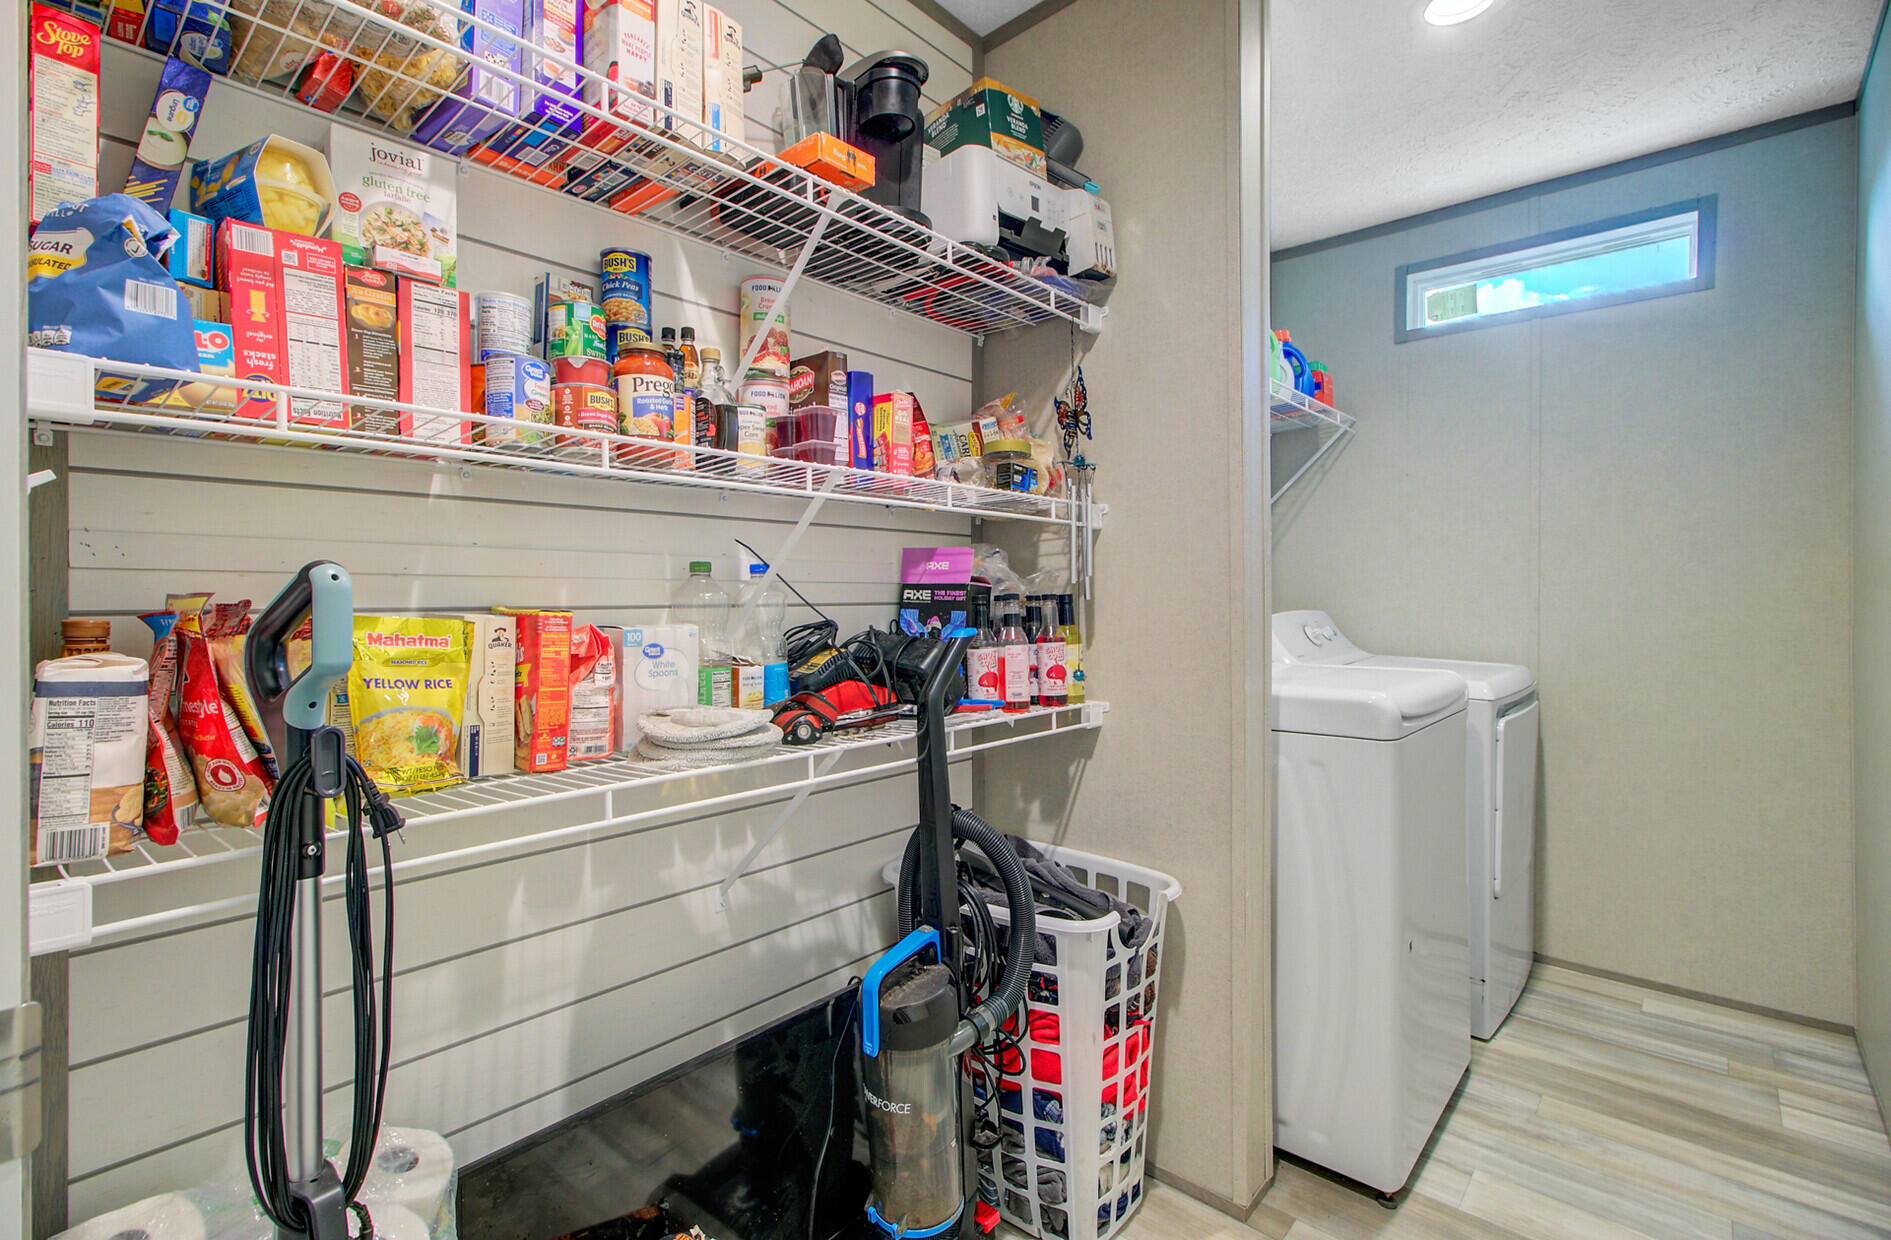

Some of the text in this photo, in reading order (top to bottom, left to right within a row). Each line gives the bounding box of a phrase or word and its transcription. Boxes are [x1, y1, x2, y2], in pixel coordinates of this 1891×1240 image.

[36, 21, 91, 45] Stove
[56, 42, 84, 58] Top
[626, 49, 647, 63] HAPPY
[369, 142, 423, 171] jovial
[361, 175, 431, 203] gluten free
[604, 257, 635, 270] BUSH'S
[602, 281, 640, 291] Chick Peas
[351, 287, 392, 302] Au Gratin
[246, 358, 274, 370] fresh
[926, 562, 950, 570] AXE
[903, 590, 932, 600] AXE
[367, 632, 450, 648] Mahatma
[626, 631, 642, 642] 100
[488, 642, 512, 651] QUAKER
[652, 660, 676, 669] White
[648, 668, 678, 678] Spoons
[363, 678, 453, 690] YELLOW RICE
[47, 719, 95, 728] Calories 110
